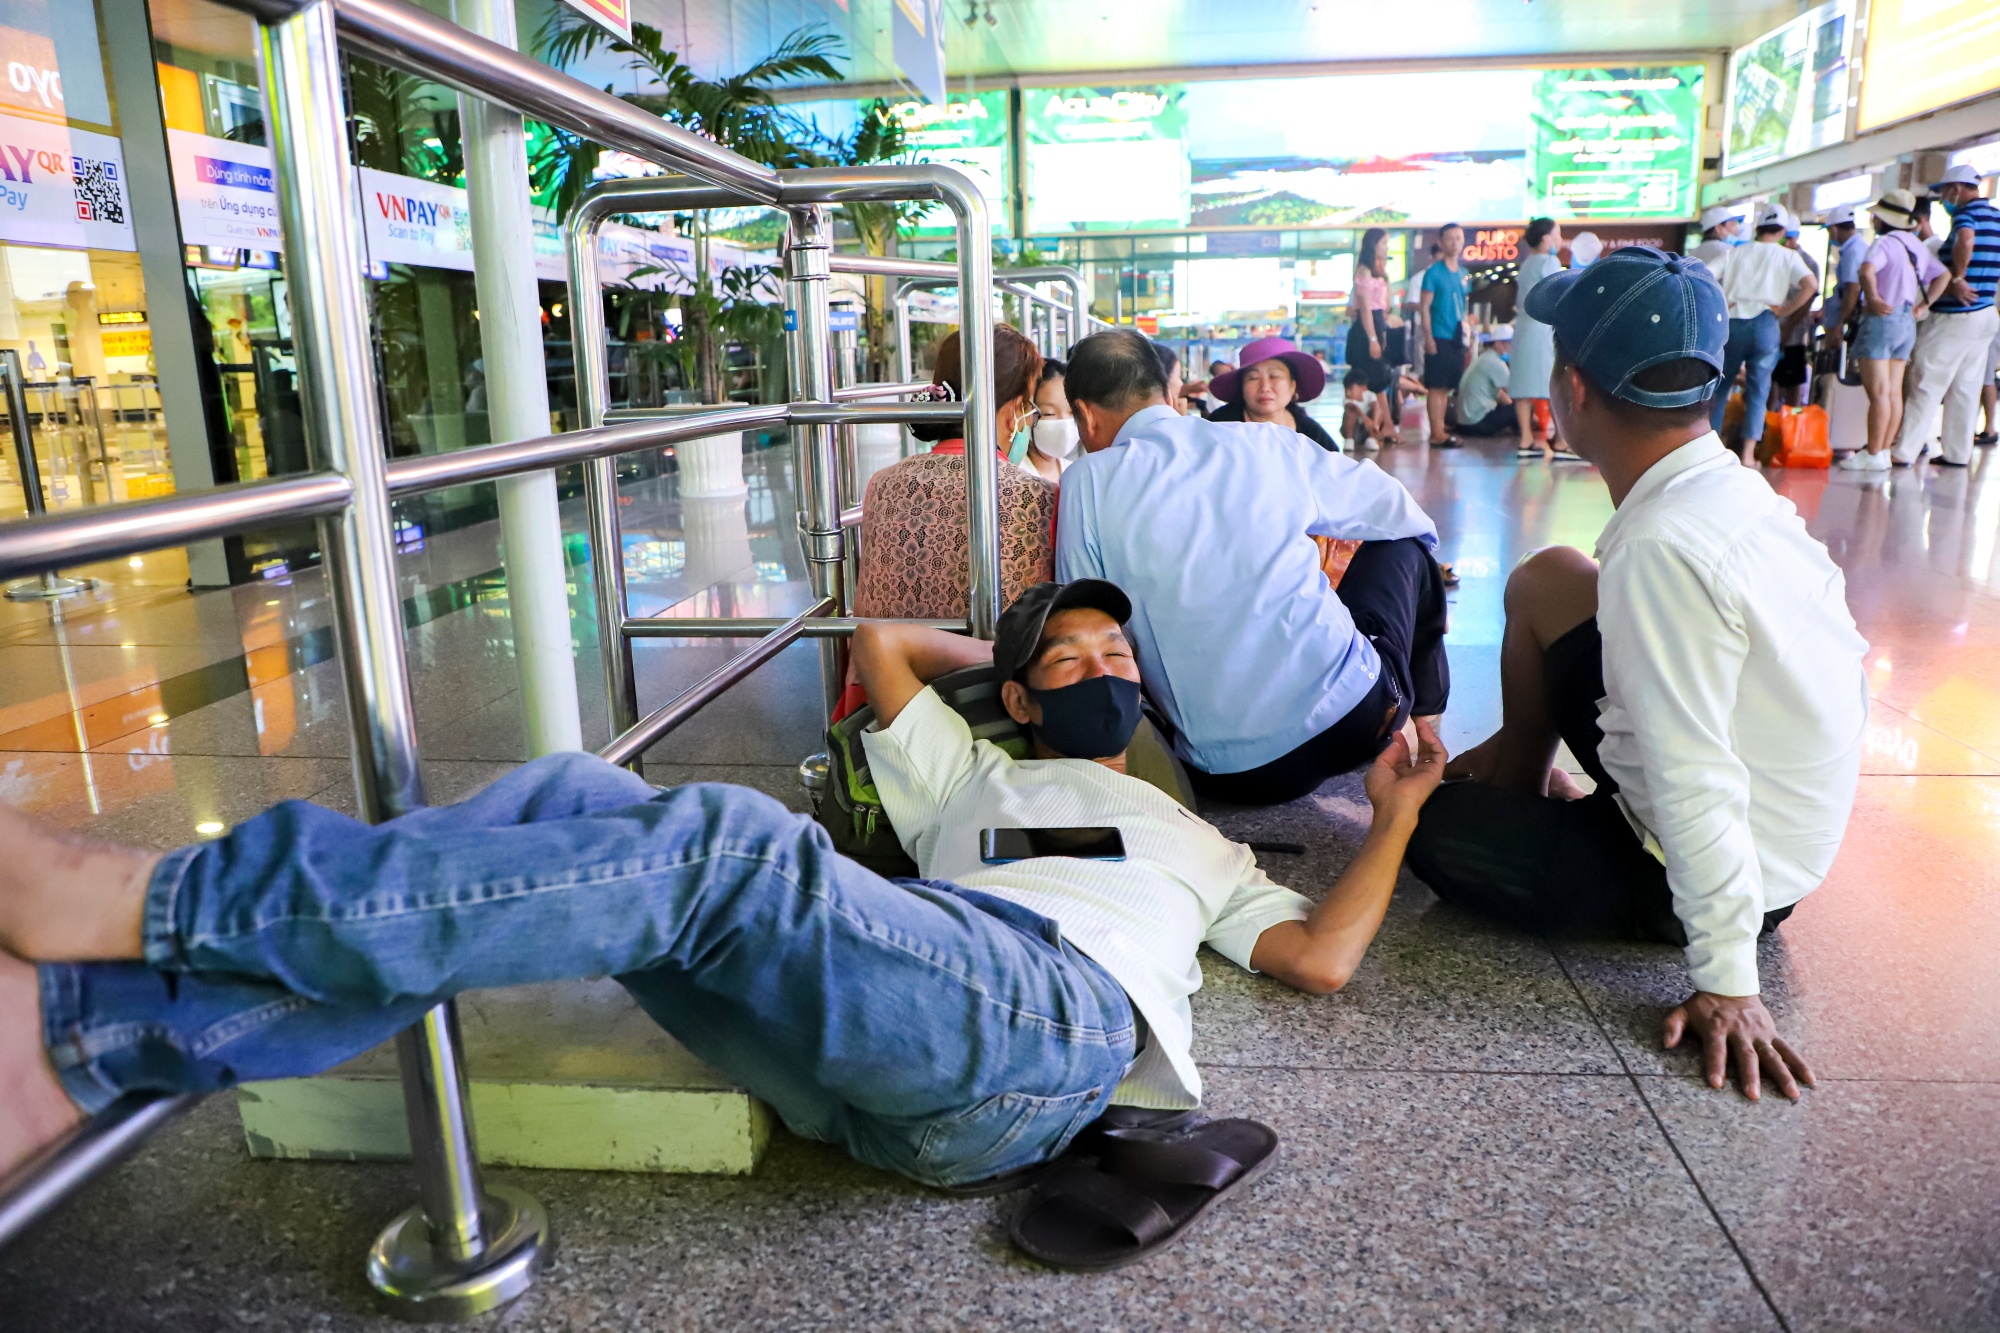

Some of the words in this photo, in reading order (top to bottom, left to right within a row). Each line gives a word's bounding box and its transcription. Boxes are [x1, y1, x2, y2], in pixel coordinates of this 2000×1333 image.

[388, 223, 408, 239] Scan
[410, 228, 419, 240] to
[420, 228, 435, 246] Pay
[1476, 230, 1519, 246] PURO
[1462, 245, 1519, 261] GUSTO
